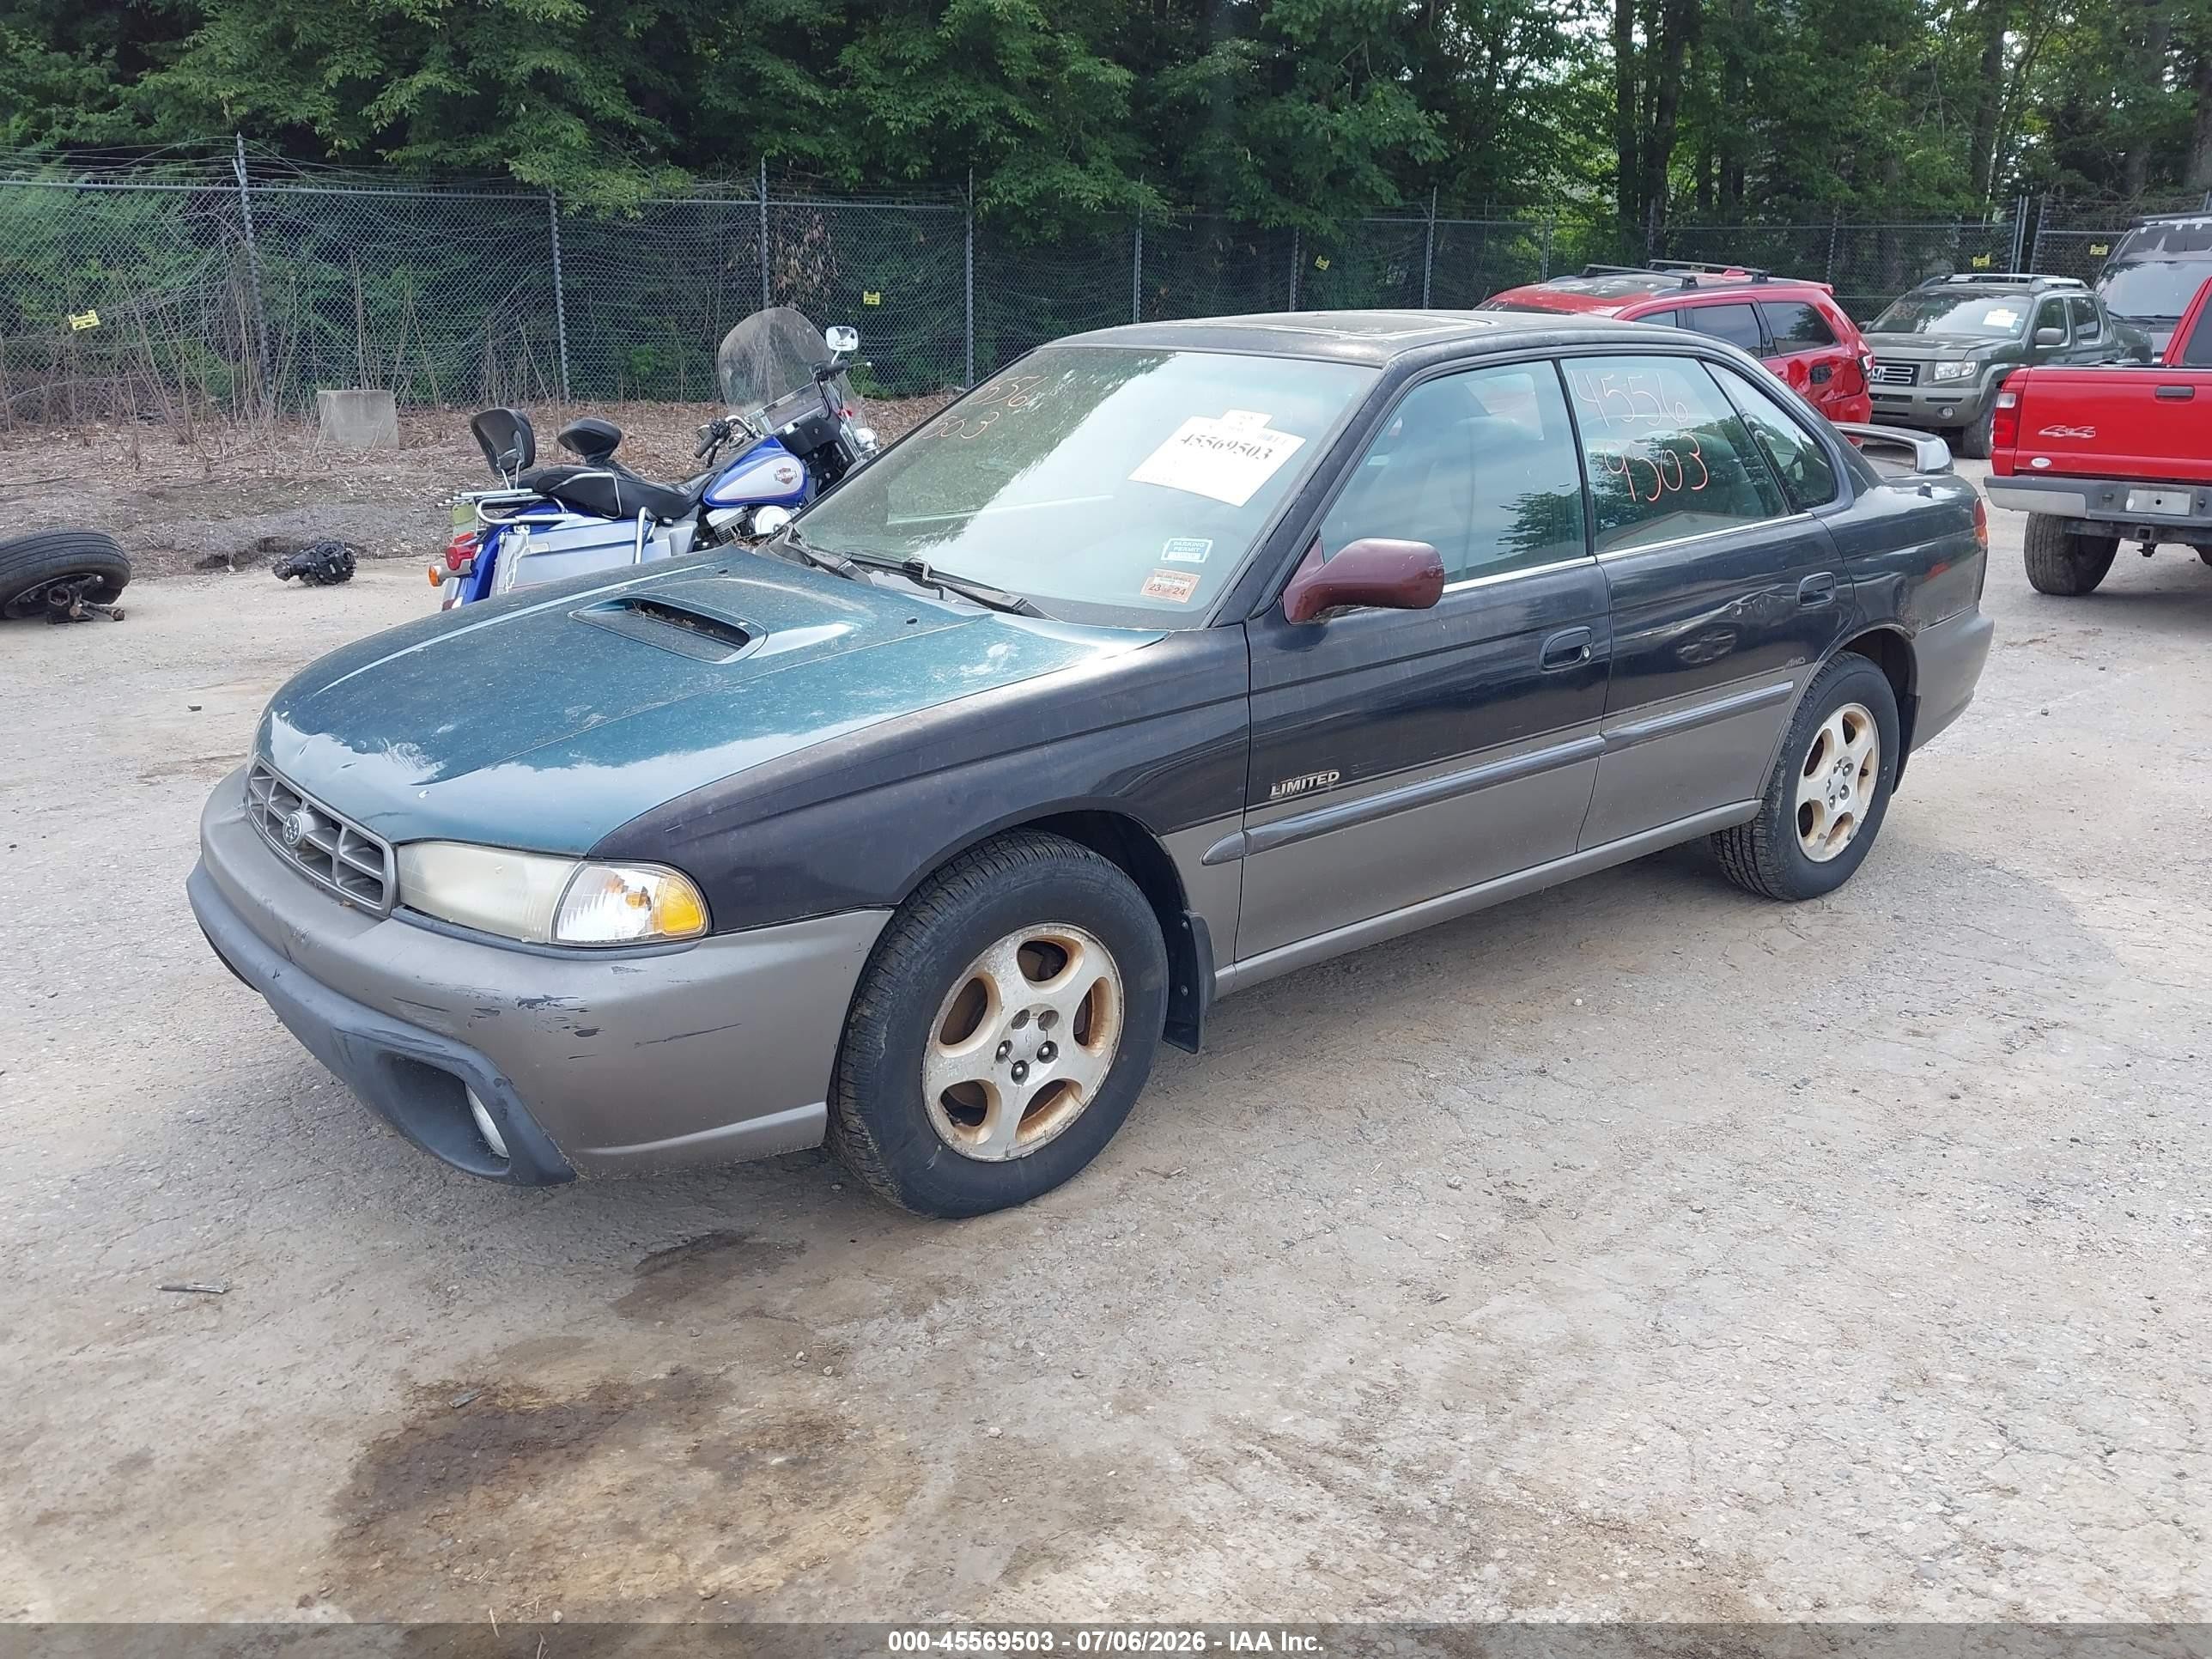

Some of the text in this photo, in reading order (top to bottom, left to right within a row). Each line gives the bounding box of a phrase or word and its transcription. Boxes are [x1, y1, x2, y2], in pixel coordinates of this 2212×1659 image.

[1570, 370, 1689, 428] 4556
[1181, 433, 1274, 459] 45569503
[1603, 434, 1709, 502] 9503
[1147, 583, 1162, 592] 23
[1172, 586, 1187, 596] 24
[1270, 771, 1340, 797] LIMITED
